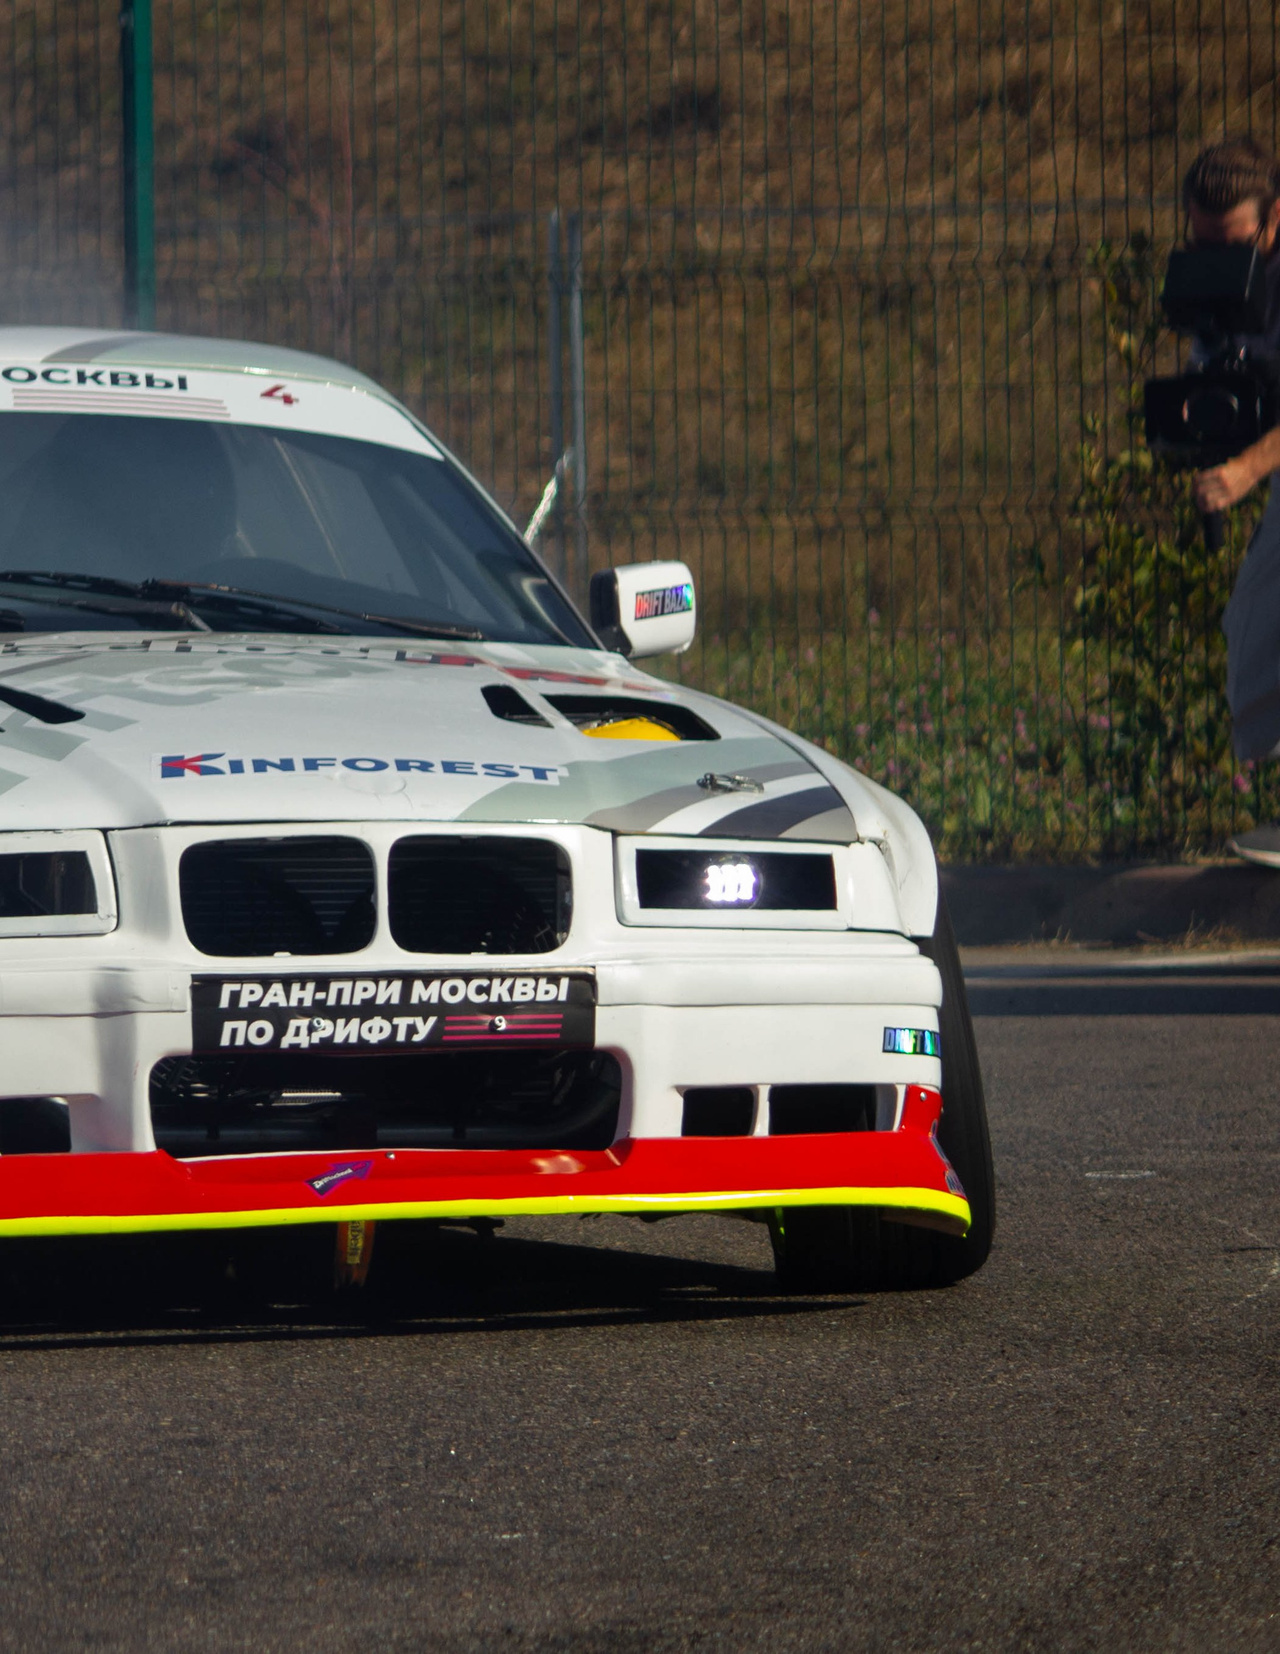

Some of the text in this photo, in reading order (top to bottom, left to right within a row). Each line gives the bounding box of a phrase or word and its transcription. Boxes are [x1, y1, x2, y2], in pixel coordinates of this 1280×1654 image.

[260, 384, 300, 406] 4
[635, 590, 664, 619] DRIFT
[158, 752, 558, 782] KINFOREST
[219, 977, 570, 1009] ГРАН-ПРИ МОСКВЫ
[219, 1015, 438, 1049] ПО ДРИФТУ
